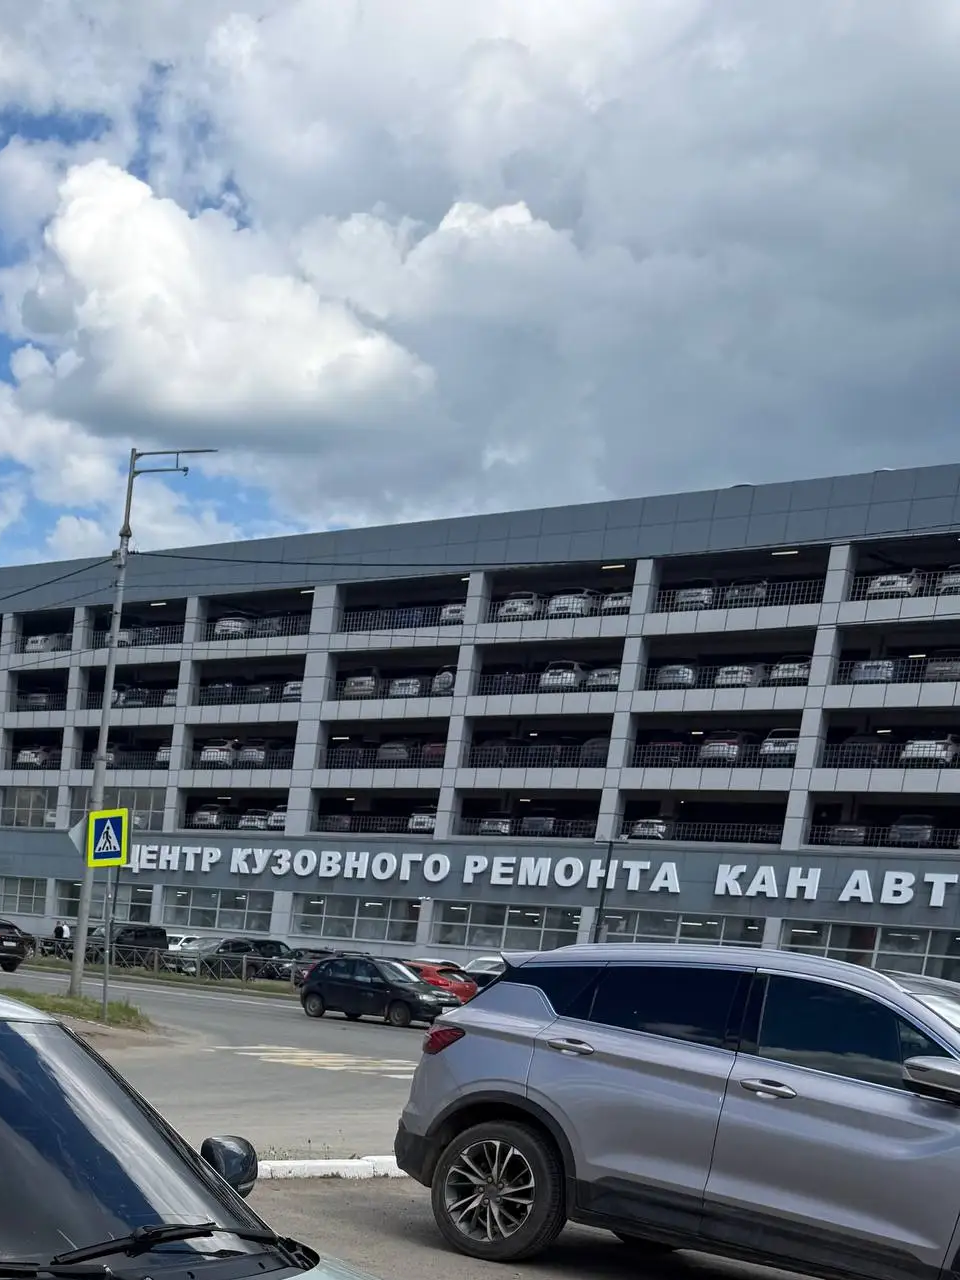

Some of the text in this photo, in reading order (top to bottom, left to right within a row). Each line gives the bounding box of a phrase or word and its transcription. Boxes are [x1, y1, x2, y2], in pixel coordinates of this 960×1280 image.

[229, 847, 451, 883] КУЗОВНОГО
[462, 855, 681, 893] РЕМОНТА
[714, 864, 821, 900] КАН
[838, 869, 959, 907] АВТ
